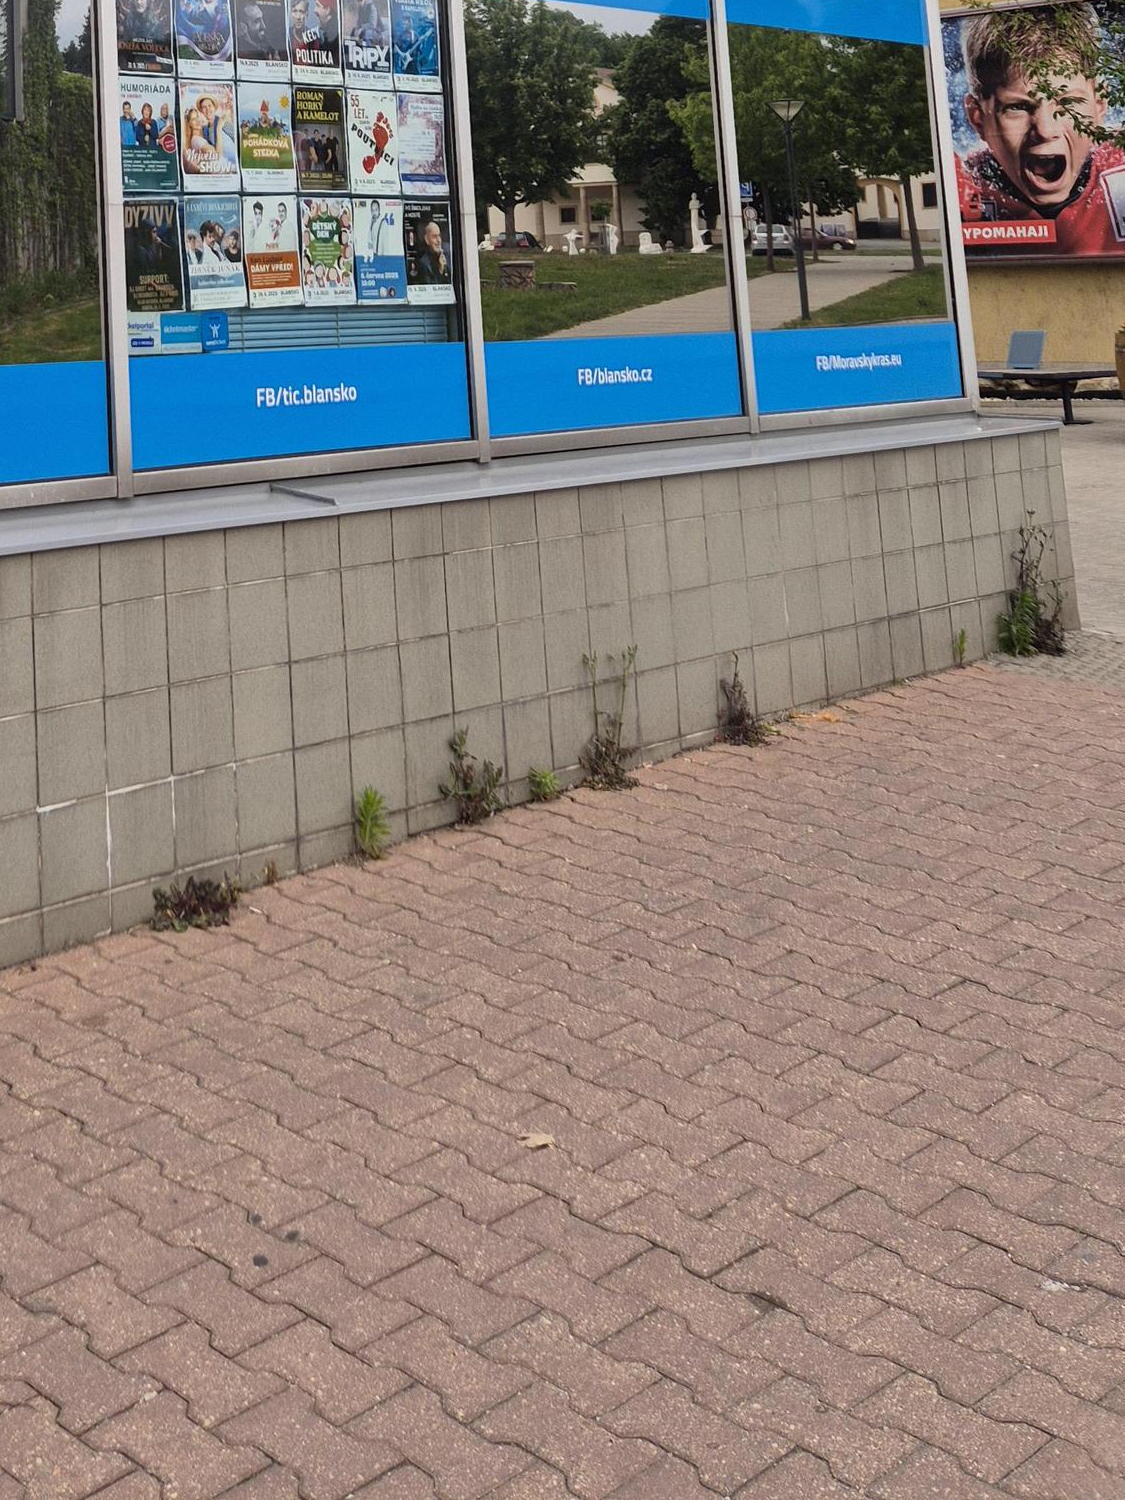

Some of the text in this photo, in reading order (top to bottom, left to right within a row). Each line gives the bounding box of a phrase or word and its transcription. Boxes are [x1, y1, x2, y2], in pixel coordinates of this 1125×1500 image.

[295, 48, 334, 66] POLITIKA
[296, 91, 324, 101] ROMAN
[577, 366, 653, 386] FB/blansko.cz
[256, 382, 358, 408] FB/tic.blansko
